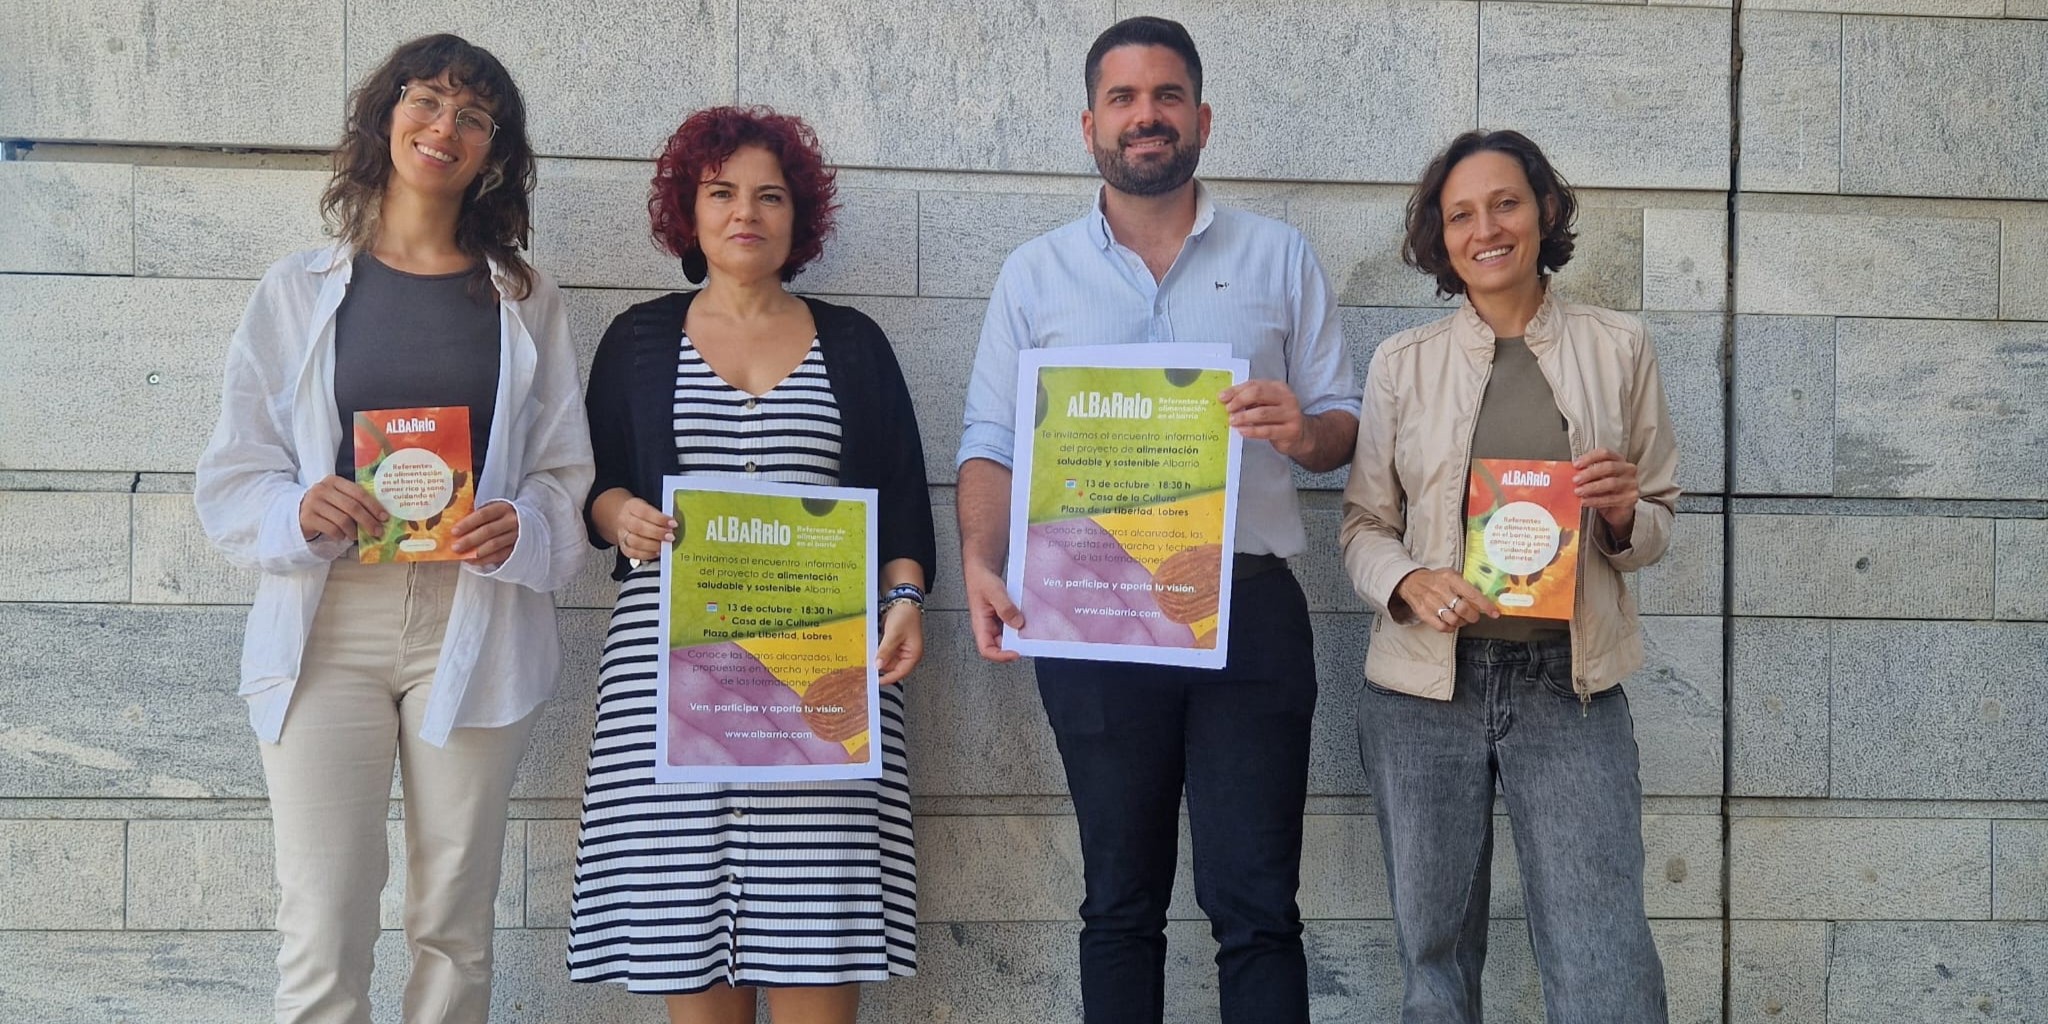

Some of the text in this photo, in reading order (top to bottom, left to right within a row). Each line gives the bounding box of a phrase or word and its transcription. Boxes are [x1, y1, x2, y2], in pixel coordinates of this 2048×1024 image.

[1159, 397, 1198, 406] Referentes
[1054, 431, 1098, 440] invitamos
[1112, 432, 1160, 441] encuentro
[1165, 432, 1219, 441] informativo
[1060, 444, 1199, 455] del proyecto de alimentación
[1057, 457, 1199, 468] saludable y sostenible Albarrio
[1085, 479, 1096, 488] 13
[1098, 480, 1111, 488] de
[1113, 480, 1150, 489] octubre
[1158, 481, 1182, 490] 18:30
[1184, 481, 1190, 489] h
[1089, 492, 1177, 502] Casa de la Cultura
[1061, 505, 1085, 514] Plaza
[1087, 506, 1100, 515] de
[1102, 507, 1111, 515] la
[1158, 507, 1188, 517] Lobres
[797, 526, 834, 534] Referentes
[1045, 525, 1082, 535] Conoce
[1085, 526, 1098, 535] las
[1100, 527, 1128, 538] logros
[1190, 528, 1203, 539] las
[797, 533, 843, 541] alimentación
[1048, 539, 1101, 551] propuestas
[1118, 541, 1156, 551] marcha
[1158, 544, 1163, 552] y
[1166, 542, 1197, 552] fechas
[693, 553, 738, 564] invitamos
[741, 557, 749, 565] al
[752, 558, 801, 567] encuentro
[805, 559, 857, 570] informativo
[1074, 552, 1087, 561] de
[1089, 553, 1102, 562] las
[700, 567, 838, 581] del proyecto de alimentación
[697, 581, 841, 594] saludable y sostenible Albarrio
[1043, 578, 1063, 588] Ven,
[1066, 579, 1109, 590] participa
[1120, 582, 1151, 592] aporta
[1155, 583, 1163, 591] tu
[1167, 582, 1196, 593] visión.
[740, 604, 753, 612] de
[755, 605, 792, 614] octubre
[801, 607, 825, 615] 18:30
[827, 607, 833, 615] h
[1074, 606, 1161, 618] www.albarrio.com
[732, 617, 820, 627] Casa de la Cultura
[703, 629, 728, 638] Plaza
[731, 630, 743, 638] de
[746, 630, 755, 639] la
[802, 632, 832, 641] Lobres
[688, 650, 848, 664] Conoce las logros alcanzados, las
[692, 663, 746, 674] propuestas
[764, 665, 802, 674] marcha
[804, 667, 809, 676] y
[812, 665, 843, 675] fechas
[721, 676, 734, 685] de
[736, 677, 749, 686] las
[690, 702, 846, 715] Ven, participa y aporta tu visión.
[725, 729, 812, 740] www.albarrio.com
